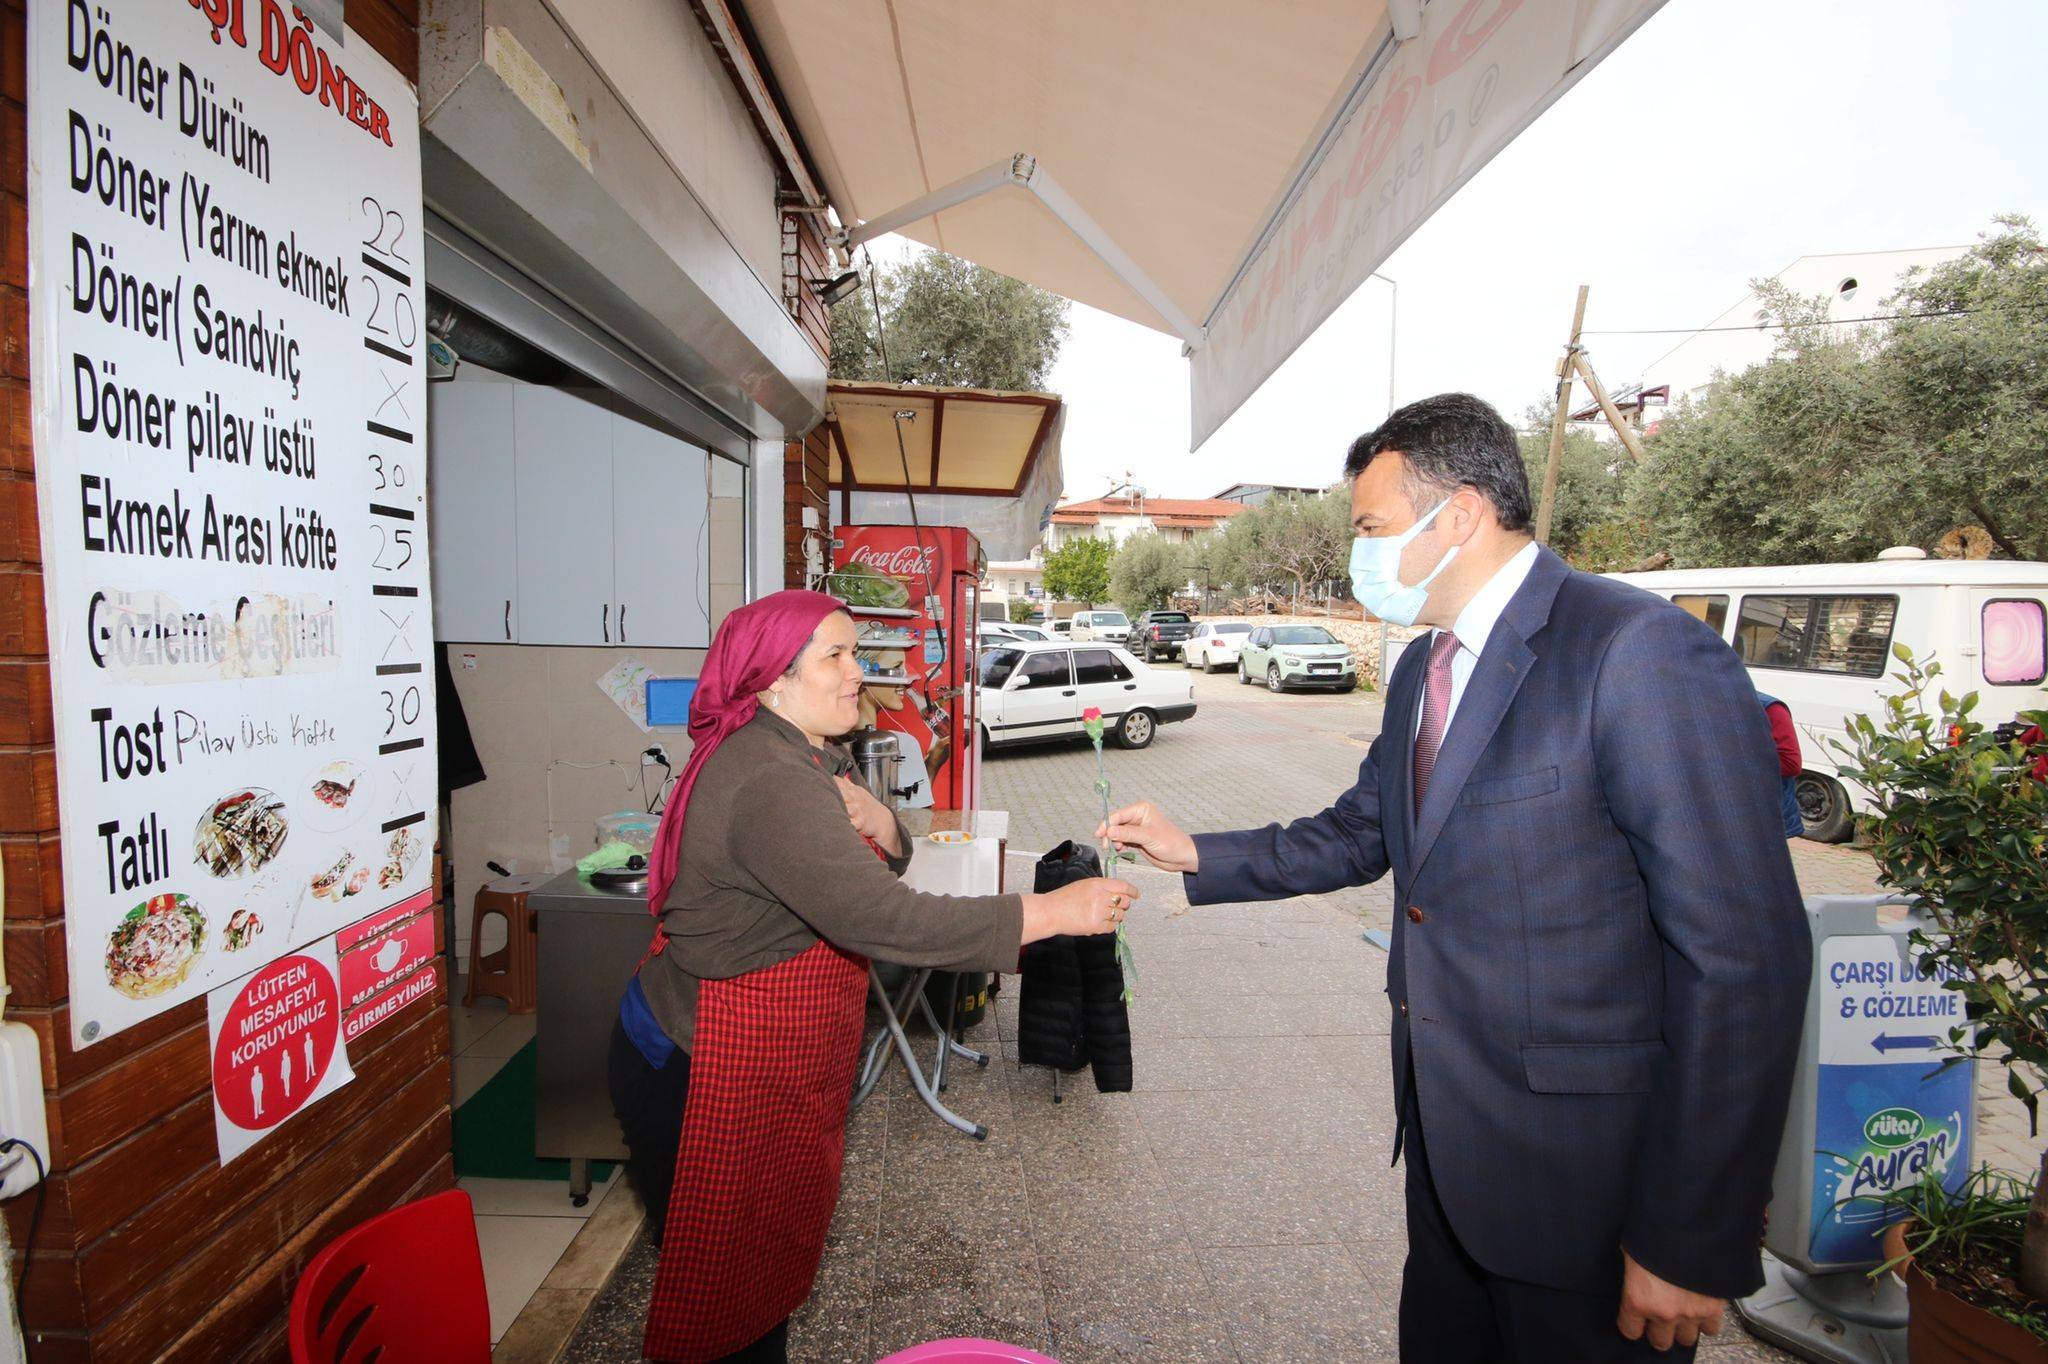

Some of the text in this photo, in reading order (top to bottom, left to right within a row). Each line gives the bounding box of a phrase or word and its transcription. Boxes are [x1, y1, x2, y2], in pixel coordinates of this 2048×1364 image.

[68, 0, 270, 184] Döner Dürüm
[259, 0, 393, 147] DÖNER
[68, 108, 349, 317] Döner (Yarım ekmek
[362, 197, 410, 265] 22
[194, 283, 300, 400] Sandviç
[362, 275, 416, 348] 20
[73, 353, 315, 479] Döner pilav üstü
[368, 454, 405, 490] 30
[81, 474, 337, 571] Ekmek Arası köfte
[369, 524, 412, 569] 25
[88, 591, 226, 668] Gözleme
[91, 705, 166, 782] Tost
[174, 710, 235, 764] Pilav
[381, 686, 420, 738] 30
[98, 812, 169, 894] Tatlı
[240, 978, 316, 1037] MESAFEYİ
[248, 963, 307, 1007] LÜTFEN
[347, 973, 433, 1036] GİRMEYİNİZ
[352, 955, 427, 1005] MASKESİZ
[1830, 961, 1893, 989] ÇARŞI
[1840, 991, 1957, 1018] & GÖZLEME
[231, 1000, 326, 1069] KORUYUNUZ
[1850, 1132, 1947, 1197] Ayran
